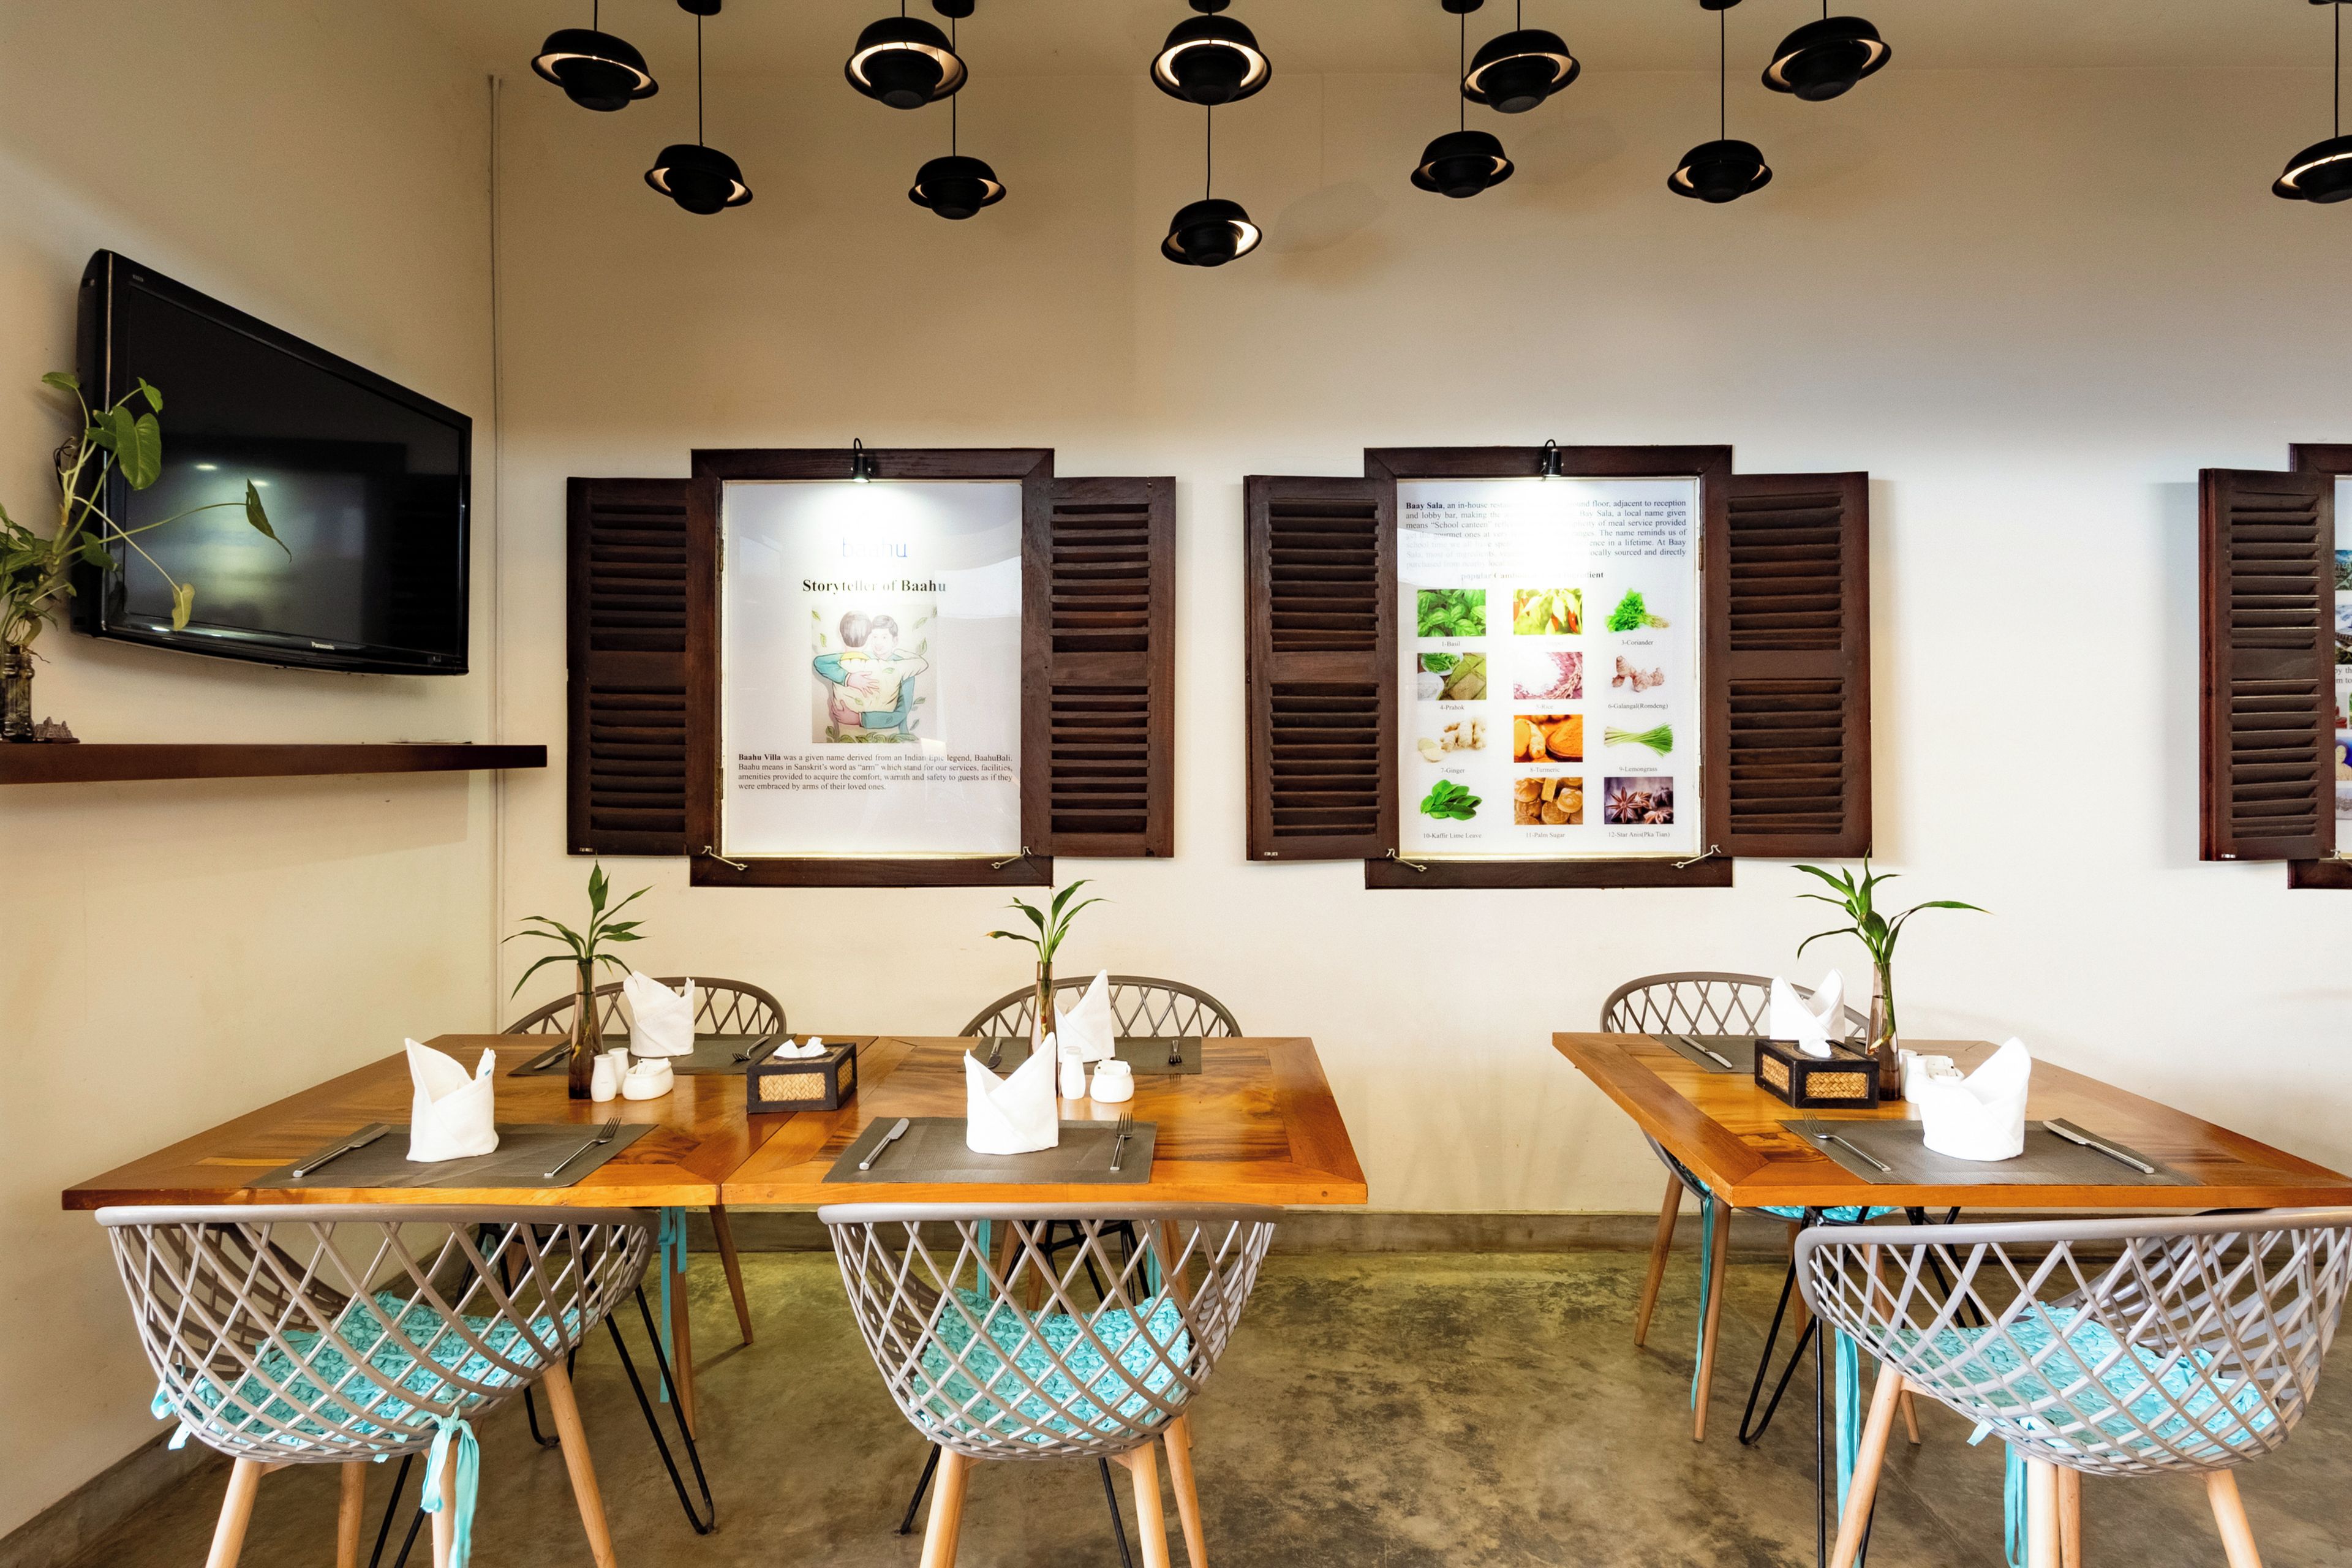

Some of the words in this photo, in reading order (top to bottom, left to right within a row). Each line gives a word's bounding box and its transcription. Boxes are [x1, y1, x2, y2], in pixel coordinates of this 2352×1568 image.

[1406, 502, 1425, 511] Baay
[1613, 500, 1643, 508] adjacent
[1654, 500, 1686, 508] reception
[1422, 511, 1441, 521] lobby
[1461, 511, 1487, 520] making
[1580, 510, 1593, 518] Bay
[1667, 509, 1686, 518] given
[1655, 519, 1686, 528] provided
[1433, 531, 1462, 540] gourmet
[1668, 538, 1686, 548] Baay
[1660, 548, 1686, 557] directly
[1406, 560, 1441, 570] purchased
[803, 579, 876, 595] Storyteller
[883, 579, 897, 592] of
[902, 579, 946, 592] Baahu
[805, 754, 824, 763] given
[929, 754, 944, 763] Epic
[946, 754, 972, 763] legend,
[773, 774, 803, 782] provided
[813, 774, 838, 782] acquire
[927, 774, 946, 783] safety
[957, 774, 979, 783] guests
[998, 774, 1012, 783] they
[792, 783, 800, 791] by
